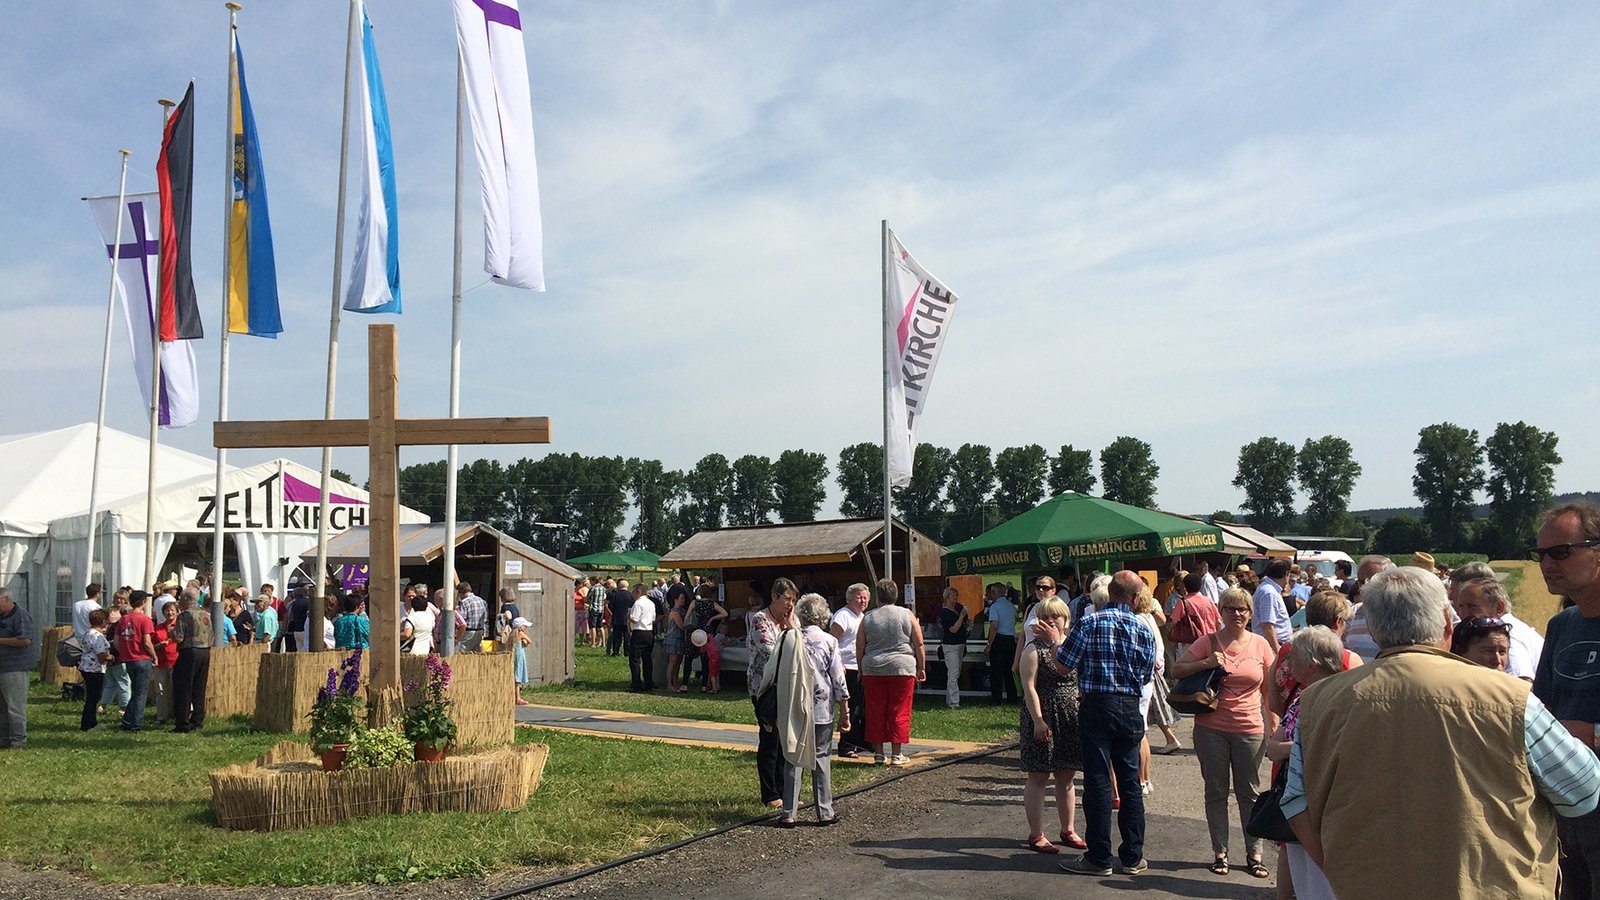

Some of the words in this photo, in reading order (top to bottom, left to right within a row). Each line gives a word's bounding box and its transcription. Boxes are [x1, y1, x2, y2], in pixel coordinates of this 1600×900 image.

[902, 279, 952, 392] KIRCHE
[197, 472, 280, 529] ZELT
[284, 504, 366, 531] KIRCH
[1068, 539, 1148, 557] MEMMINGER
[1172, 534, 1217, 549] MEMMINGER
[972, 551, 1030, 568] MEMMINGER
